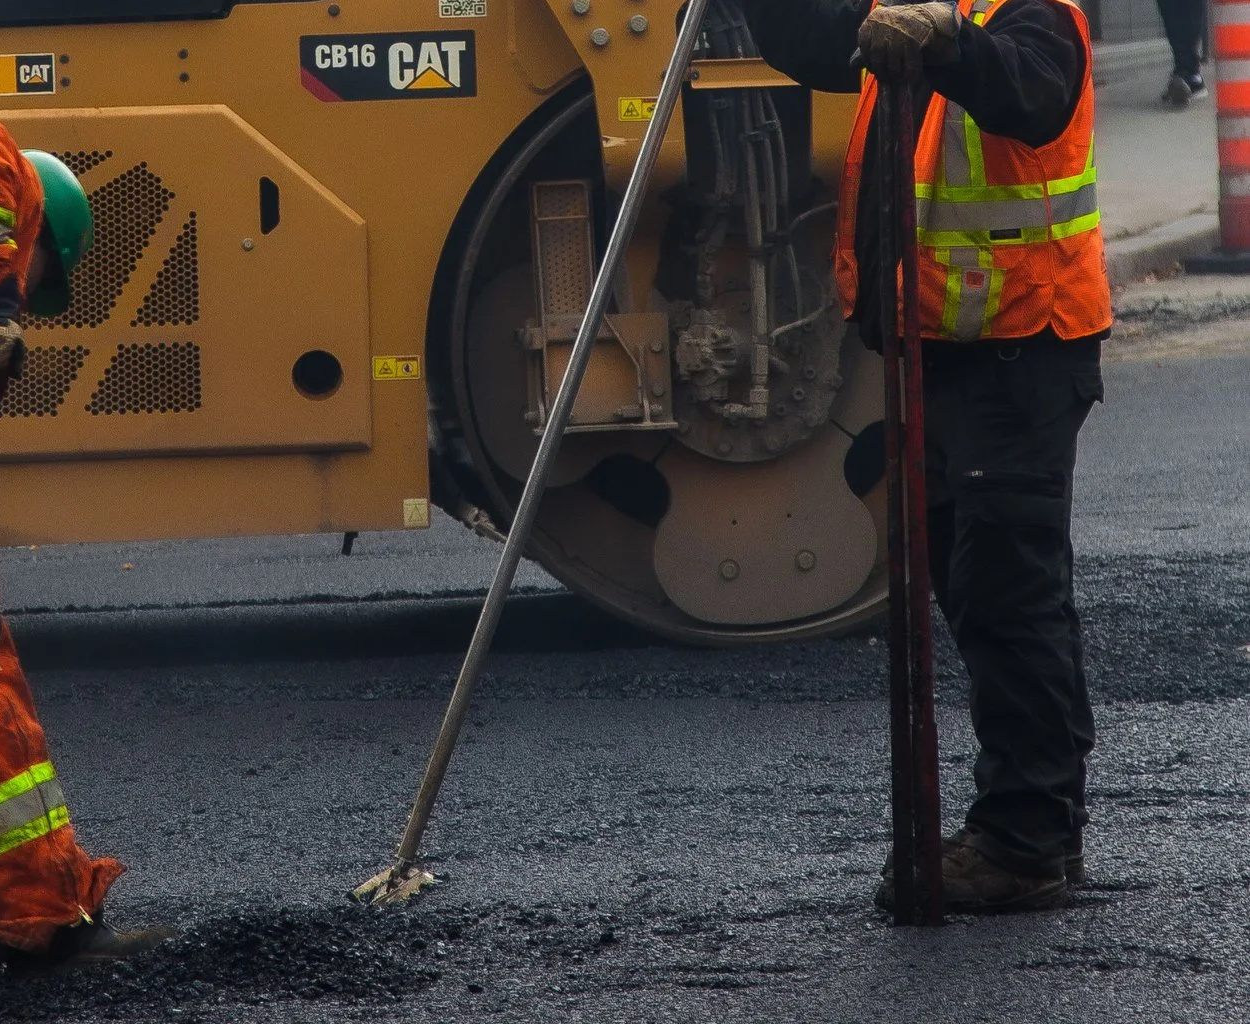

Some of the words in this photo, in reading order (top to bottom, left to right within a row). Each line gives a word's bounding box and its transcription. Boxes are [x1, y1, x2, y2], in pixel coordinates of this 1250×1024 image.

[19, 64, 51, 84] CAT
[315, 44, 375, 69] CB16
[388, 41, 466, 90] CAT
